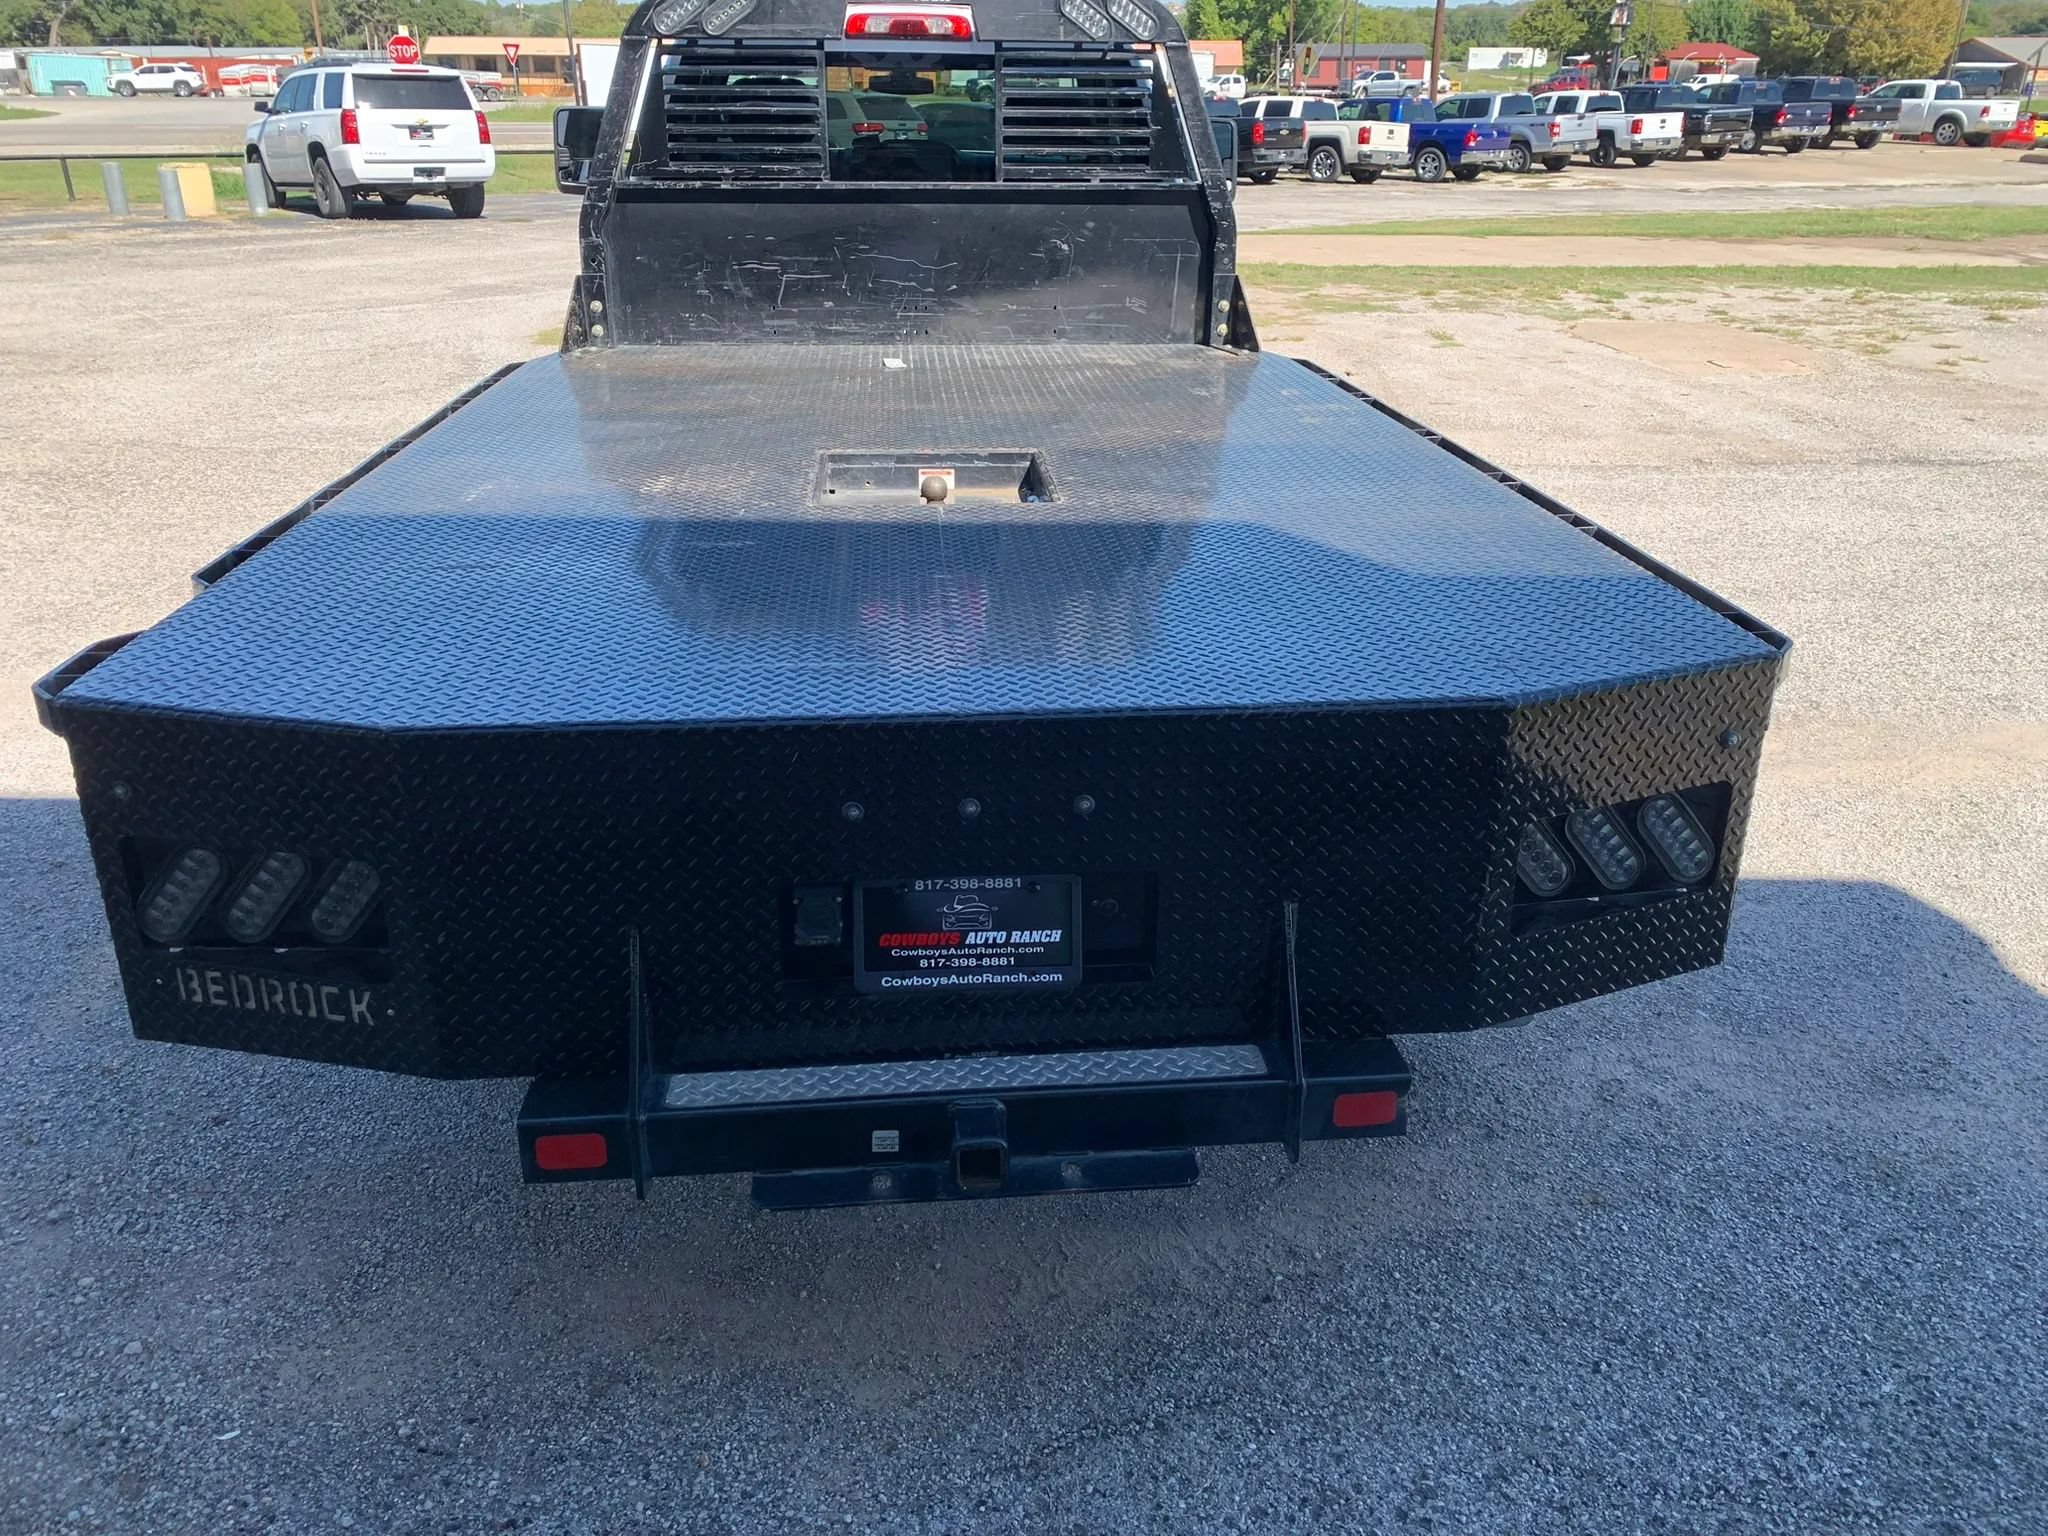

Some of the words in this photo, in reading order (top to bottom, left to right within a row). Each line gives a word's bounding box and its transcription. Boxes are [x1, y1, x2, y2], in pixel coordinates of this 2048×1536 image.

[389, 45, 417, 58] STOP
[914, 877, 1022, 891] 817-398-8881
[879, 932, 961, 947] COWBOYS
[965, 930, 1007, 944] AUTO
[1009, 929, 1062, 944] RANCH
[891, 945, 1044, 957] CowboysAutoRanch.com
[919, 957, 1015, 968] 817-398-8881
[881, 972, 1063, 987] CowboysAutoRanch.com
[175, 967, 375, 1026] BEDROCK
